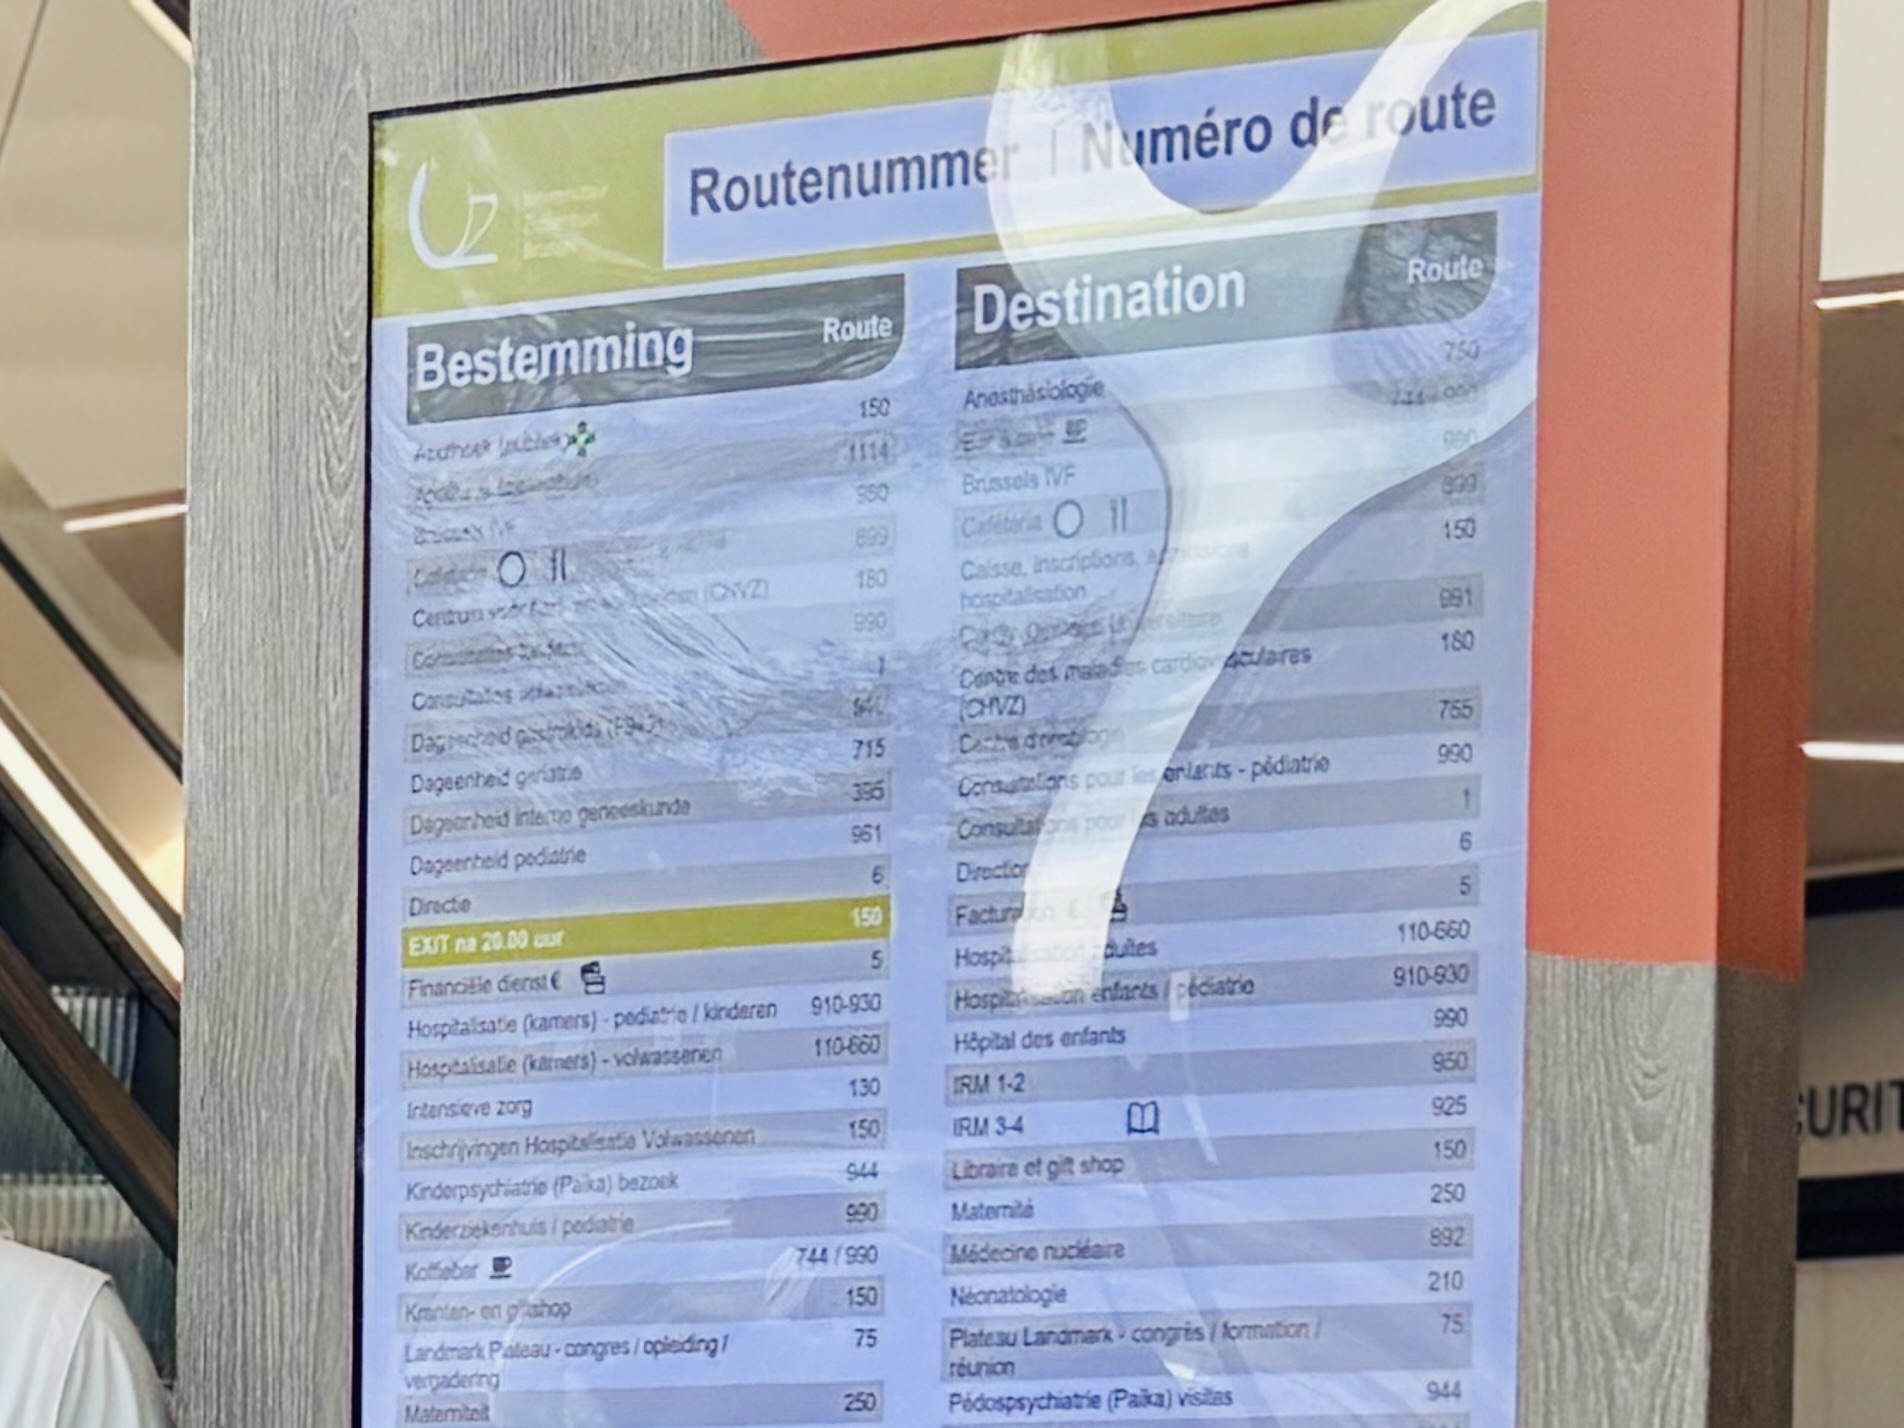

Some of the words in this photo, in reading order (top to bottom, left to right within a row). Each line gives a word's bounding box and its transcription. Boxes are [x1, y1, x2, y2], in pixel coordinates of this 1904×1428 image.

[689, 144, 1019, 216] Routenummer
[1081, 108, 1273, 171] Numéro
[1288, 95, 1344, 149] de
[1364, 84, 1497, 140] route
[973, 264, 1246, 335] Destination
[1407, 255, 1484, 285] Route
[415, 323, 694, 391] Bestemming
[822, 314, 892, 342] Route
[1044, 465, 1076, 488] IVF
[409, 850, 509, 879] Dageenheid
[513, 846, 587, 874] pediatrie
[408, 935, 448, 956] EXIT
[454, 937, 477, 953] na
[481, 930, 529, 952] 20.00
[533, 932, 564, 949] uur
[849, 906, 883, 928] 150
[407, 1014, 517, 1042] Hospitalisatie
[522, 1009, 598, 1038] (kamers)
[613, 1005, 688, 1033] pediatrie
[703, 1002, 778, 1024] kinderen
[809, 993, 882, 1016] 910-930
[953, 1030, 1017, 1057] Hôpital
[1020, 1029, 1055, 1049] des
[1059, 1026, 1127, 1048] enfants
[1431, 1006, 1468, 1029] 990
[407, 1055, 517, 1082] Hospitalisatie
[521, 1050, 597, 1079] (kamers)
[614, 1048, 722, 1069] volwassenen
[814, 1034, 881, 1058] 110-660
[952, 1074, 990, 1095] IRM
[995, 1073, 1026, 1093] 1-2
[1430, 1050, 1468, 1073] 950
[407, 1100, 491, 1121] Intensieve
[495, 1101, 533, 1120] zorg
[847, 1076, 881, 1099] 130
[952, 1116, 989, 1137] IRM
[994, 1115, 1025, 1136] 3-4
[1430, 1094, 1468, 1117] 925
[1795, 1078, 1904, 1140] URIT
[1024, 1158, 1043, 1177] et
[1046, 1156, 1075, 1181] gift
[1079, 1155, 1125, 1179] shop
[1432, 1138, 1467, 1161] 150
[950, 1199, 1035, 1222] Maternité
[1428, 1182, 1466, 1204] 250
[950, 1242, 1039, 1264] Médecine
[1042, 1239, 1126, 1261] nucléaire
[1428, 1226, 1466, 1248] 892
[949, 1283, 1068, 1309] Néonatologie
[1426, 1270, 1464, 1293] 210
[404, 1404, 490, 1424] Materniteit
[842, 1392, 877, 1413] 250
